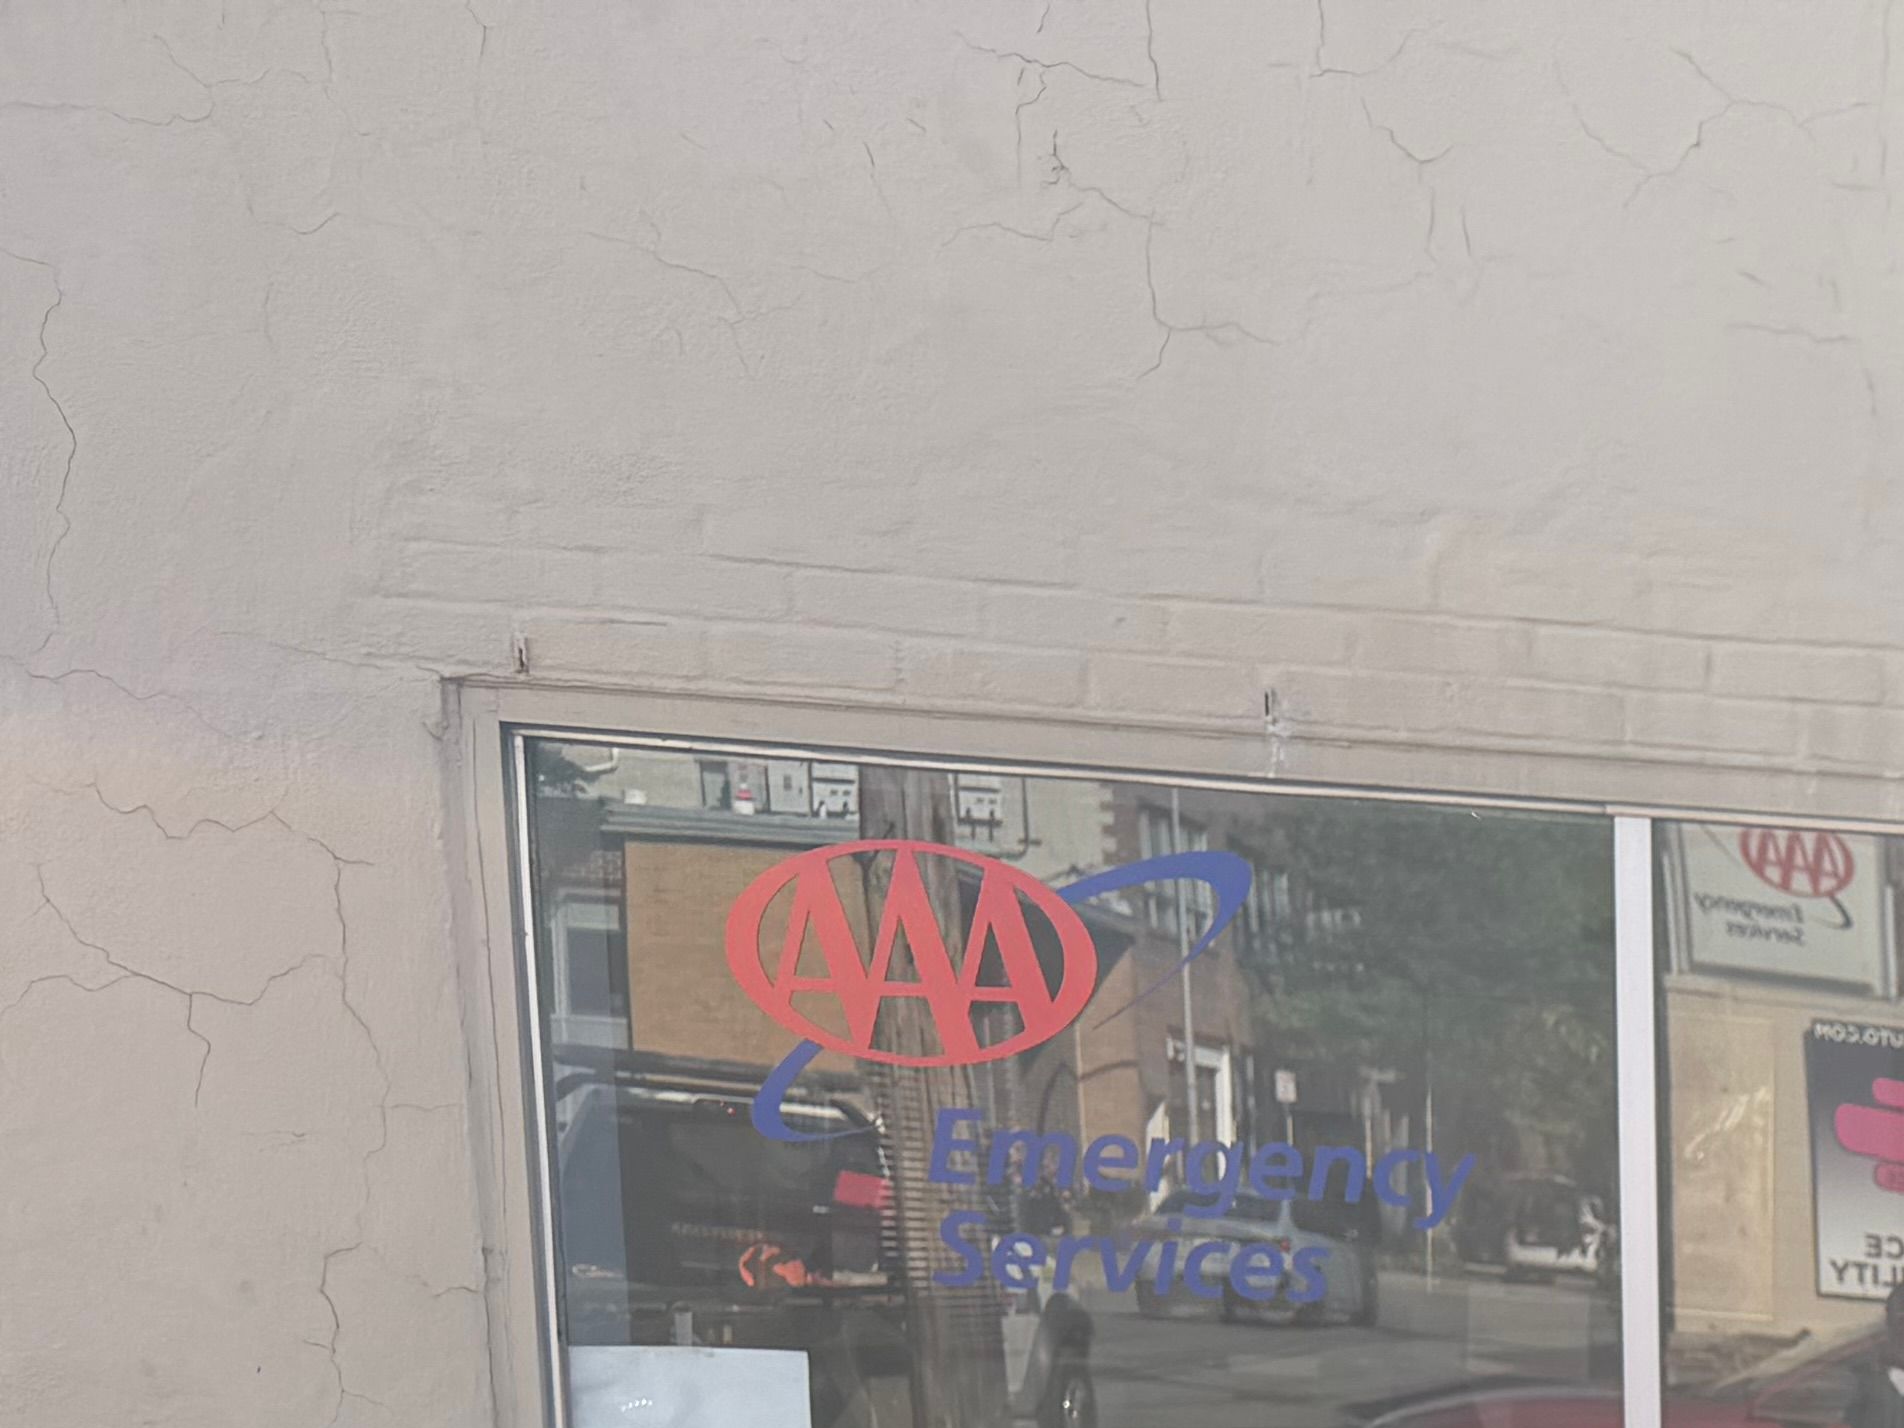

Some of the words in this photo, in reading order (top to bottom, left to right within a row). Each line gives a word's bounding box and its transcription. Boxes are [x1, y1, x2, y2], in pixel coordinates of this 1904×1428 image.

[755, 840, 1070, 1064] AAA
[927, 1106, 1478, 1231] Emergency
[932, 1210, 1332, 1305] Services
